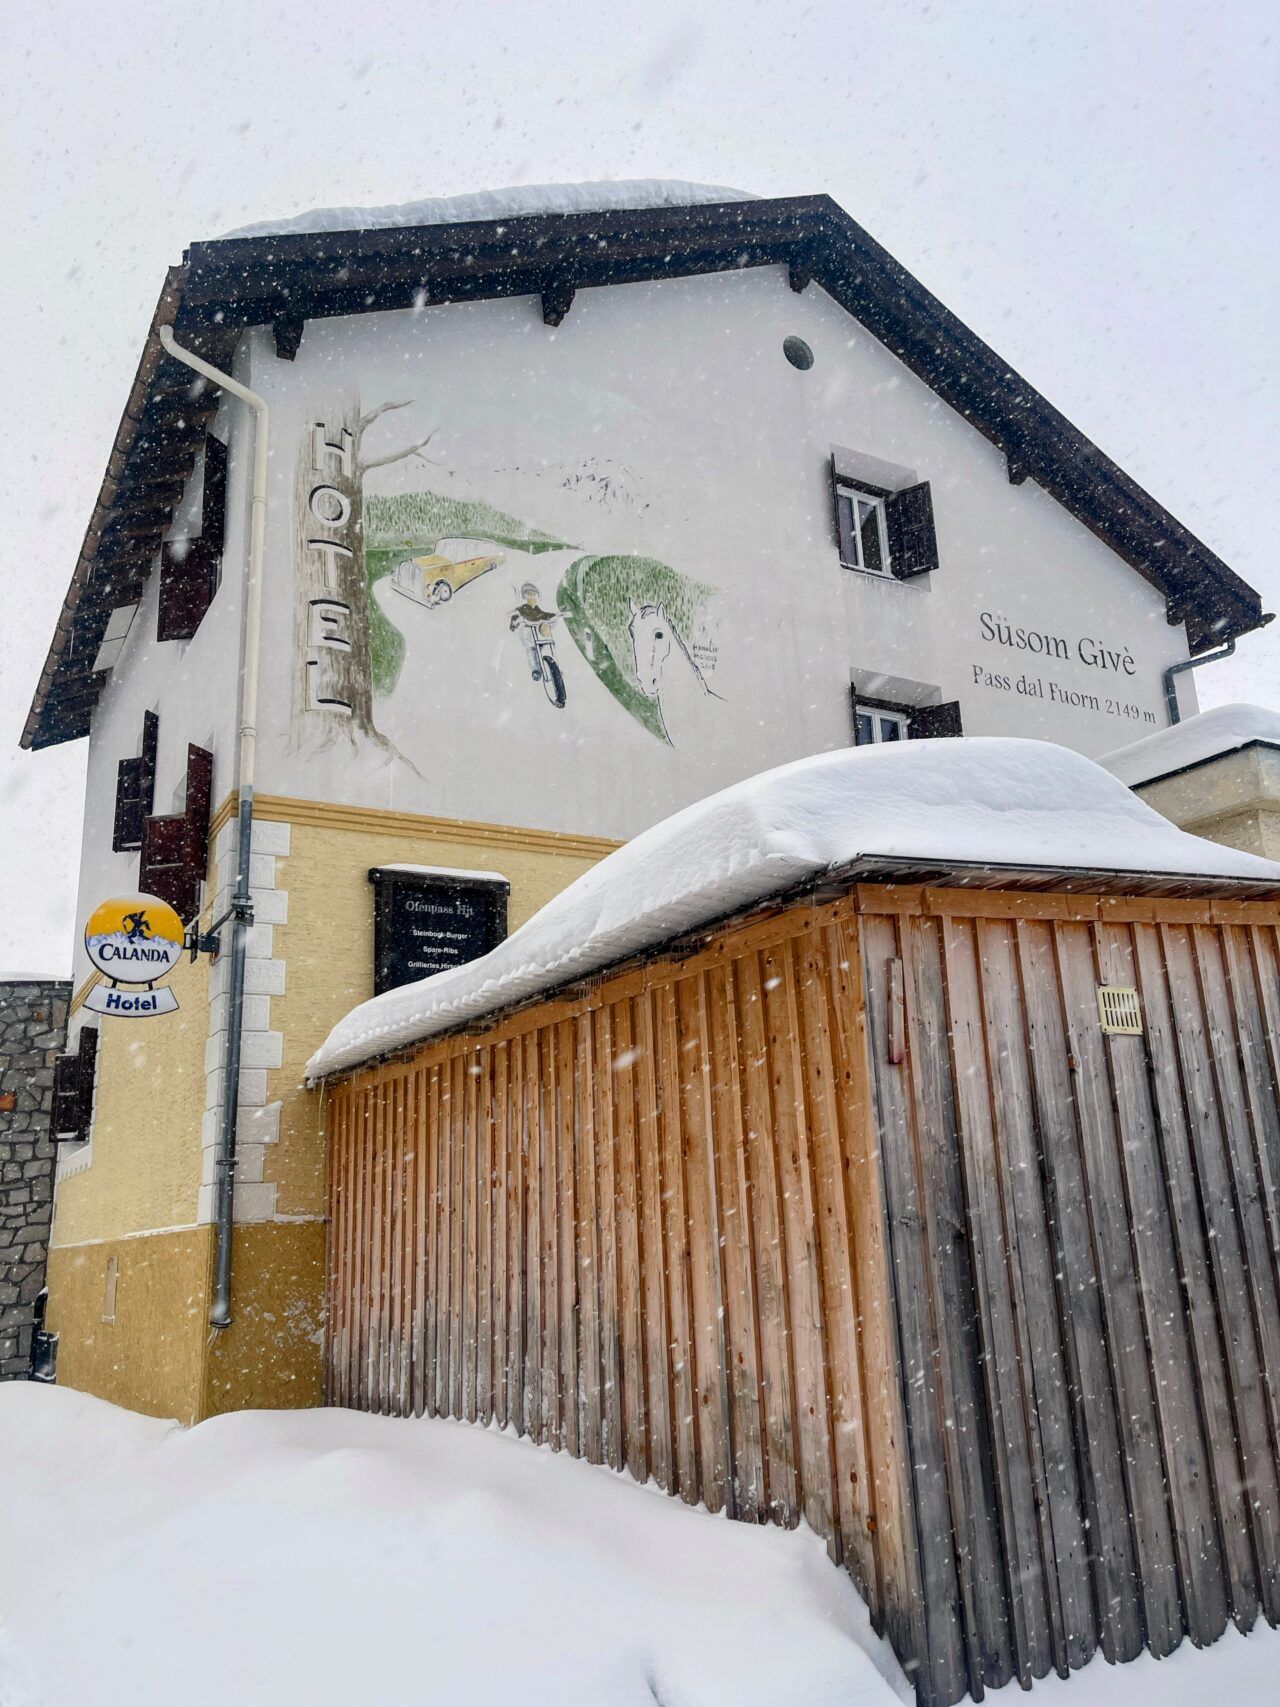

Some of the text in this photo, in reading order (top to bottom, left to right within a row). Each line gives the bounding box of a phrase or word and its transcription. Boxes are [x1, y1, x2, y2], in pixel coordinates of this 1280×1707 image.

[305, 422, 353, 715] HOTEL
[980, 612, 1136, 675] Süsom Givè
[972, 664, 1156, 723] Pass dal Fuorn 2149 m
[405, 900, 454, 914] Ofenpass
[412, 929, 468, 940] Steinbock-Burger
[98, 943, 170, 962] CALANDA
[423, 946, 458, 954] Spare-Ribs
[408, 961, 440, 969] Grilliertes
[106, 993, 157, 1010] Hotel
